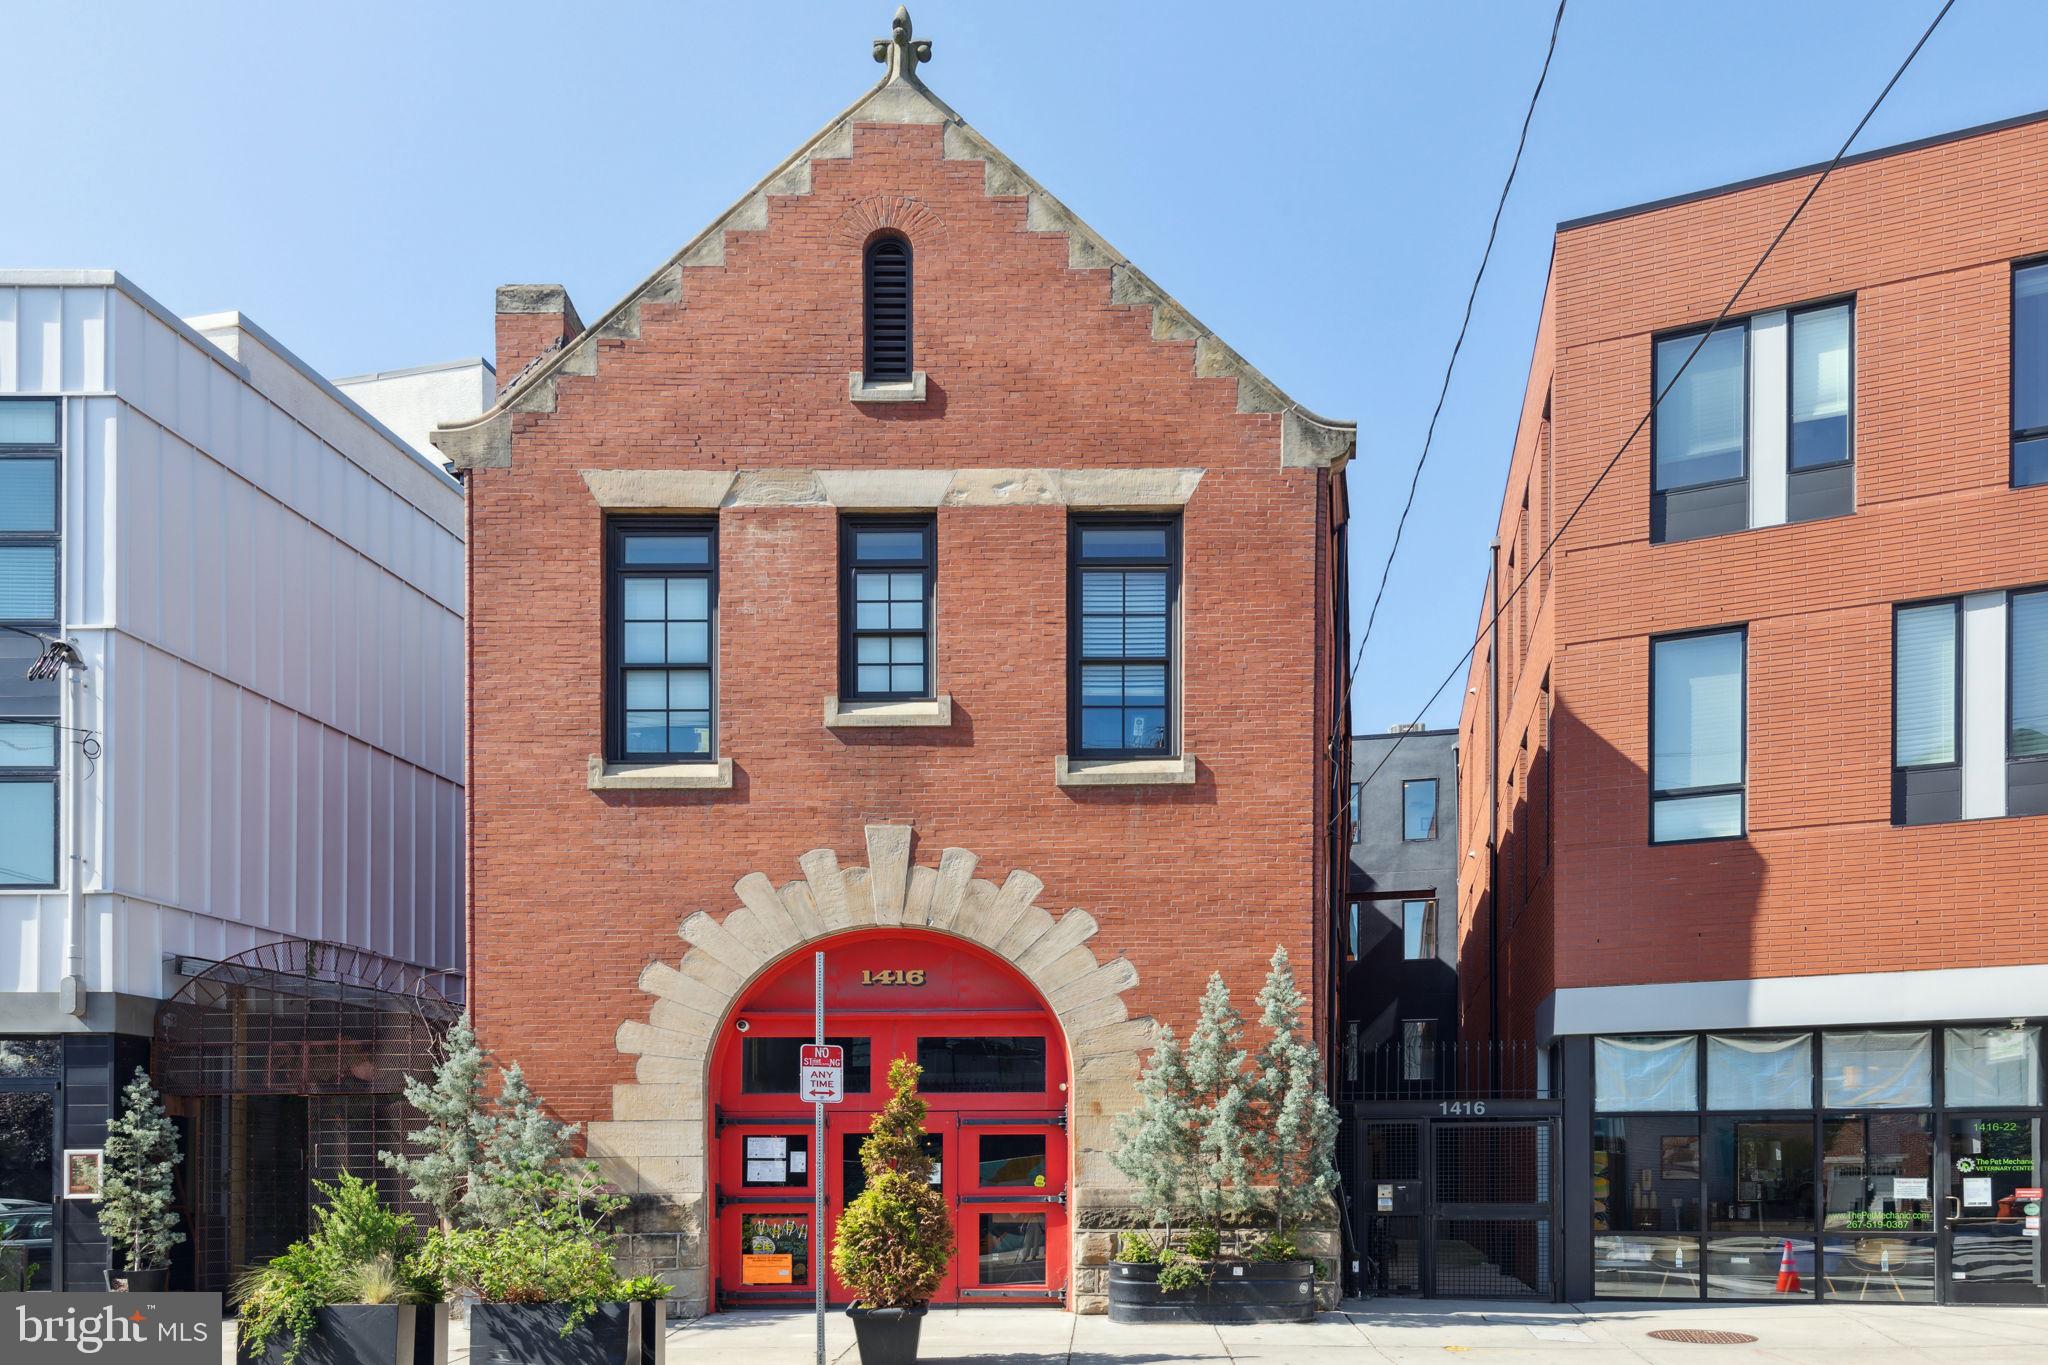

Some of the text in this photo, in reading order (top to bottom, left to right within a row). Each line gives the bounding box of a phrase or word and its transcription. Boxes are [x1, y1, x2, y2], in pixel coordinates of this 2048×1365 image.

[861, 969, 925, 986] 1416
[814, 1047, 830, 1058] NO
[803, 1057, 841, 1067] STNG
[811, 1071, 834, 1079] ANY
[810, 1080, 834, 1088] TIME
[1439, 1101, 1486, 1115] 1416
[1973, 1122, 2017, 1131] 1416-22
[1828, 1211, 1930, 1220] www.ThePetMechanic.com
[1846, 1220, 1909, 1229] 267-519-0387
